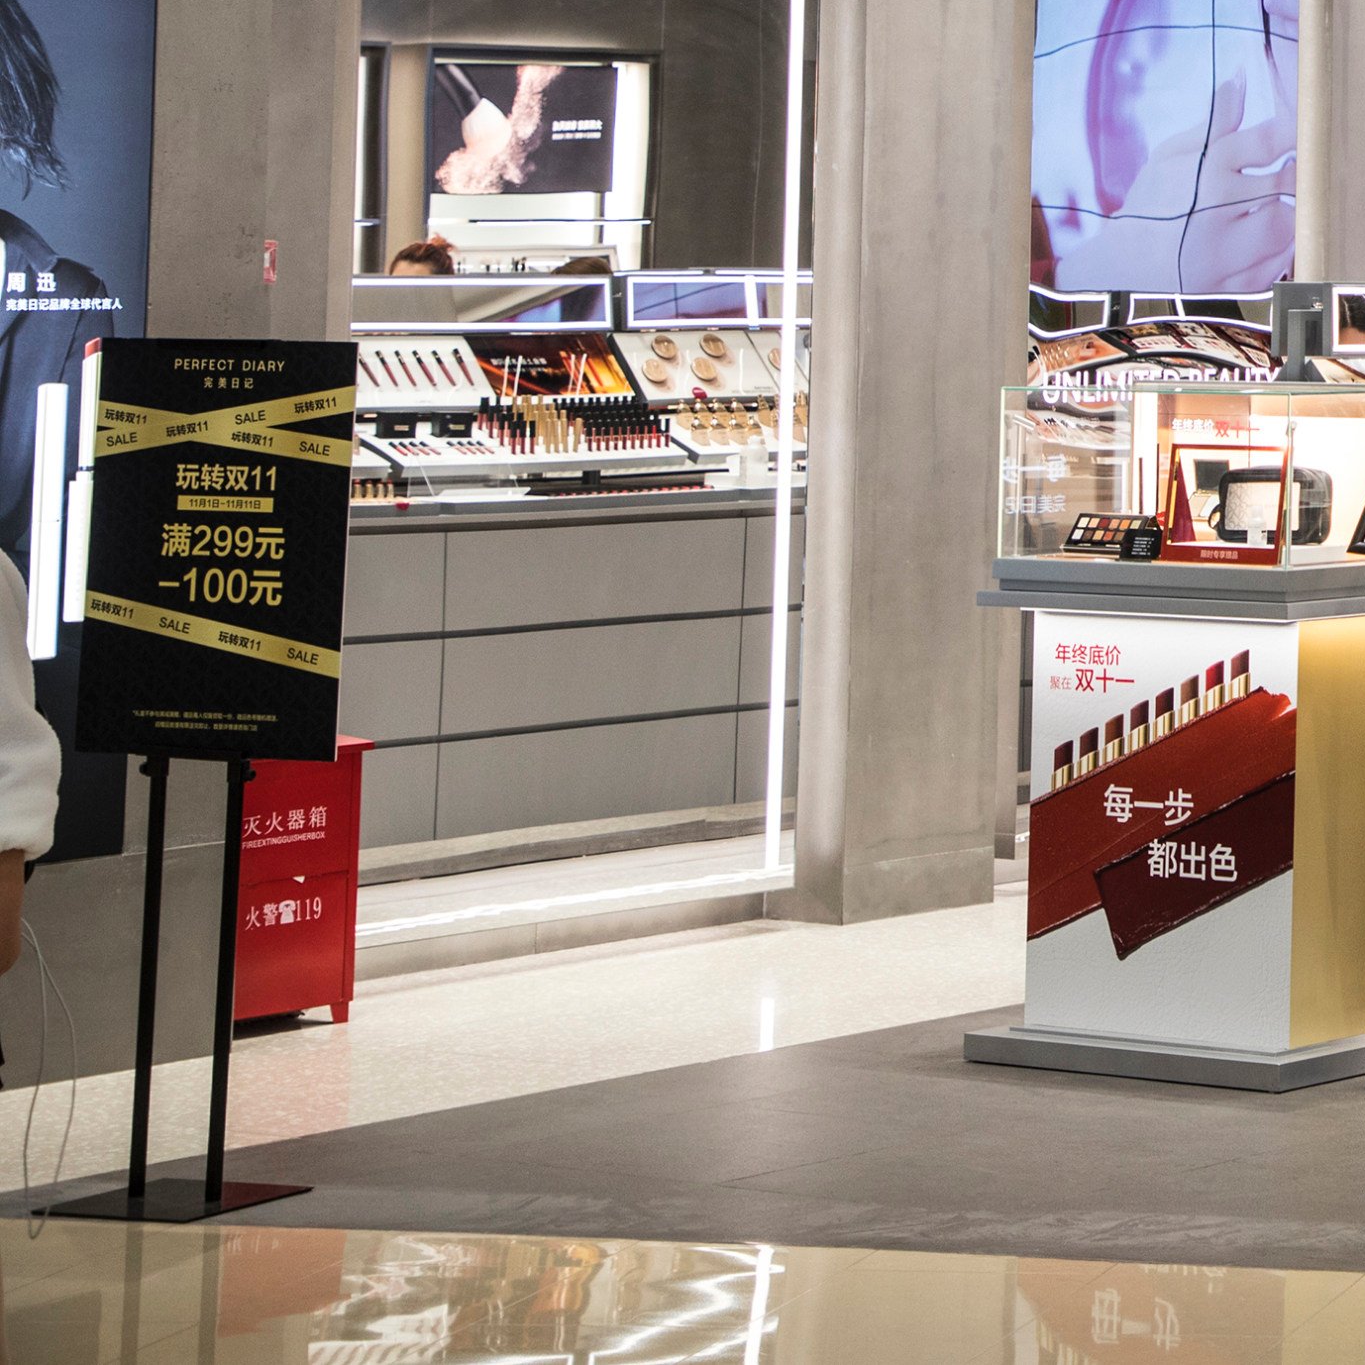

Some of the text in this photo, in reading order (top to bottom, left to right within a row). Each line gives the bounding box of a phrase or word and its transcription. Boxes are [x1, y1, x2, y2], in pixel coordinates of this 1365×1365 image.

[6, 298, 122, 311] 完美日记品牌全球代言人
[174, 358, 286, 372] PERFECT DIARY
[203, 376, 254, 389] 完美日记
[293, 396, 337, 415] 玩转双11
[104, 408, 148, 425] 玩转双11
[234, 410, 266, 426] SALE
[166, 420, 209, 438] 玩转双11
[106, 432, 138, 447] SALE
[231, 431, 273, 448] 玩转双11
[299, 441, 330, 457] SALE
[175, 463, 277, 492] 玩转双11
[189, 498, 261, 510] 11月1日-11月11日
[161, 523, 285, 560] 满299元
[158, 567, 283, 607] -100元
[91, 598, 134, 620] 玩转双11
[158, 617, 190, 634] SALE
[218, 631, 261, 652] 玩转双11
[287, 647, 319, 666] SALE
[1055, 643, 1121, 666] 年终底价
[1050, 668, 1135, 693] 聚在 双十一
[1103, 783, 1194, 826] 每一步
[242, 806, 328, 839] 灭火器箱
[1147, 838, 1238, 883] 都出色
[245, 896, 322, 931] 火警 119
